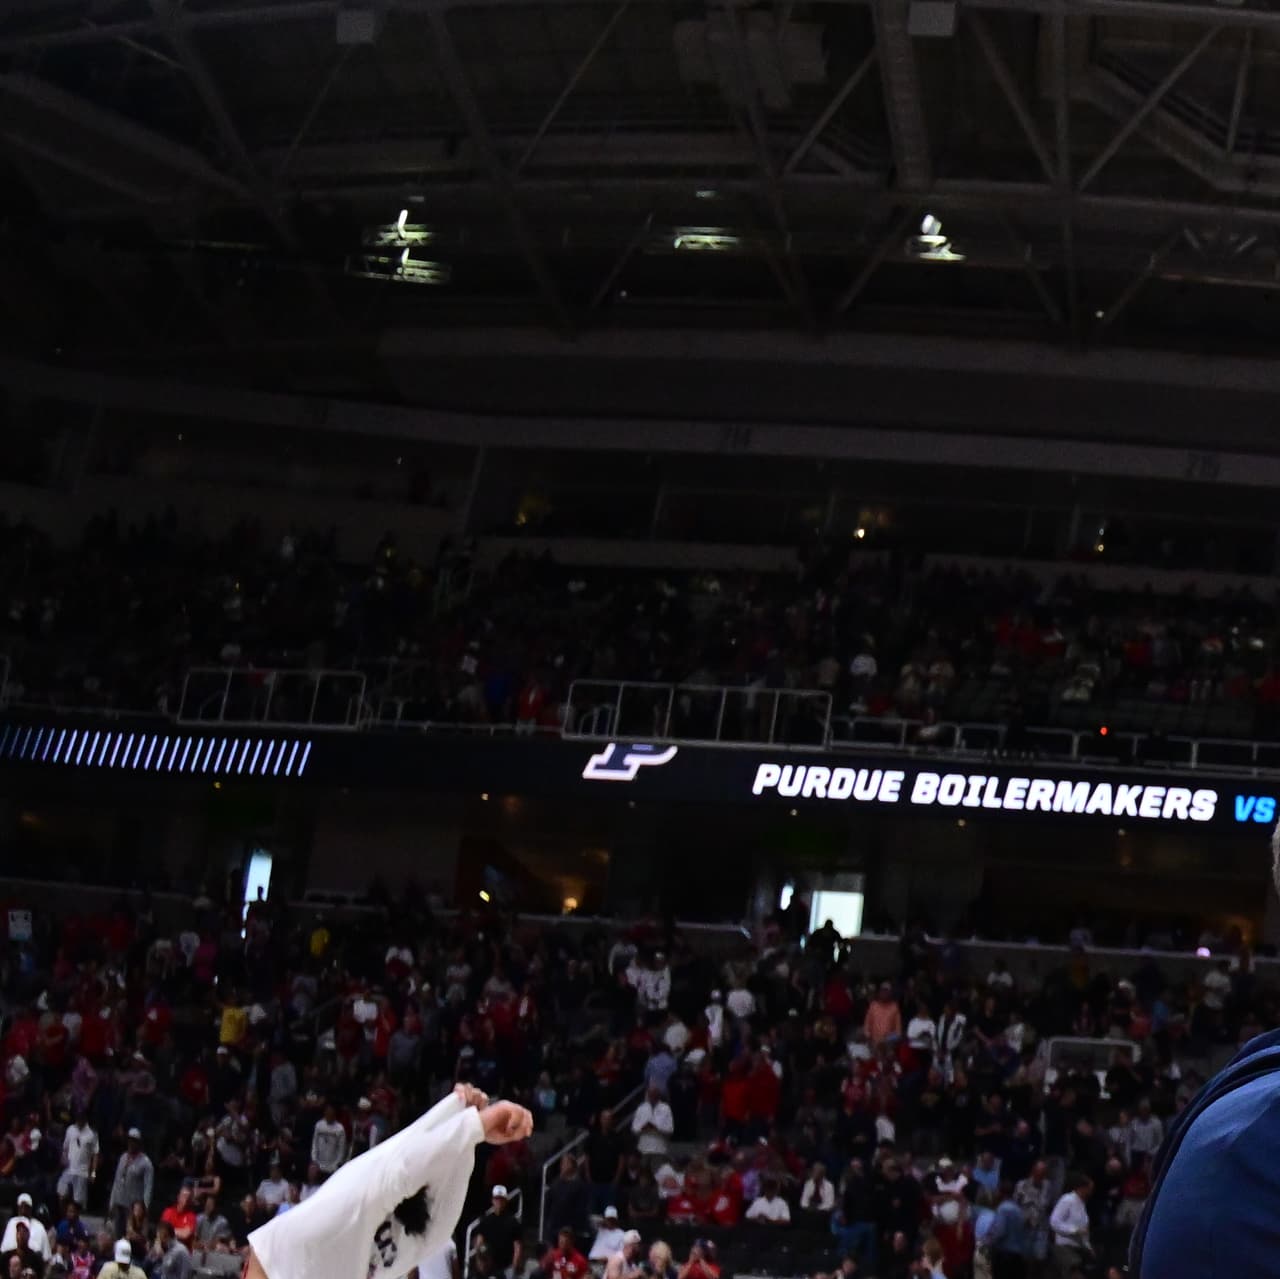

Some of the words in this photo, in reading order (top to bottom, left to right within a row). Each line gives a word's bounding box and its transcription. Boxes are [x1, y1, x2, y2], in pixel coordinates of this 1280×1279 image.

[752, 763, 905, 803] PURDUE
[910, 772, 1218, 822] BOILERMAKERS
[1234, 794, 1276, 824] VS
